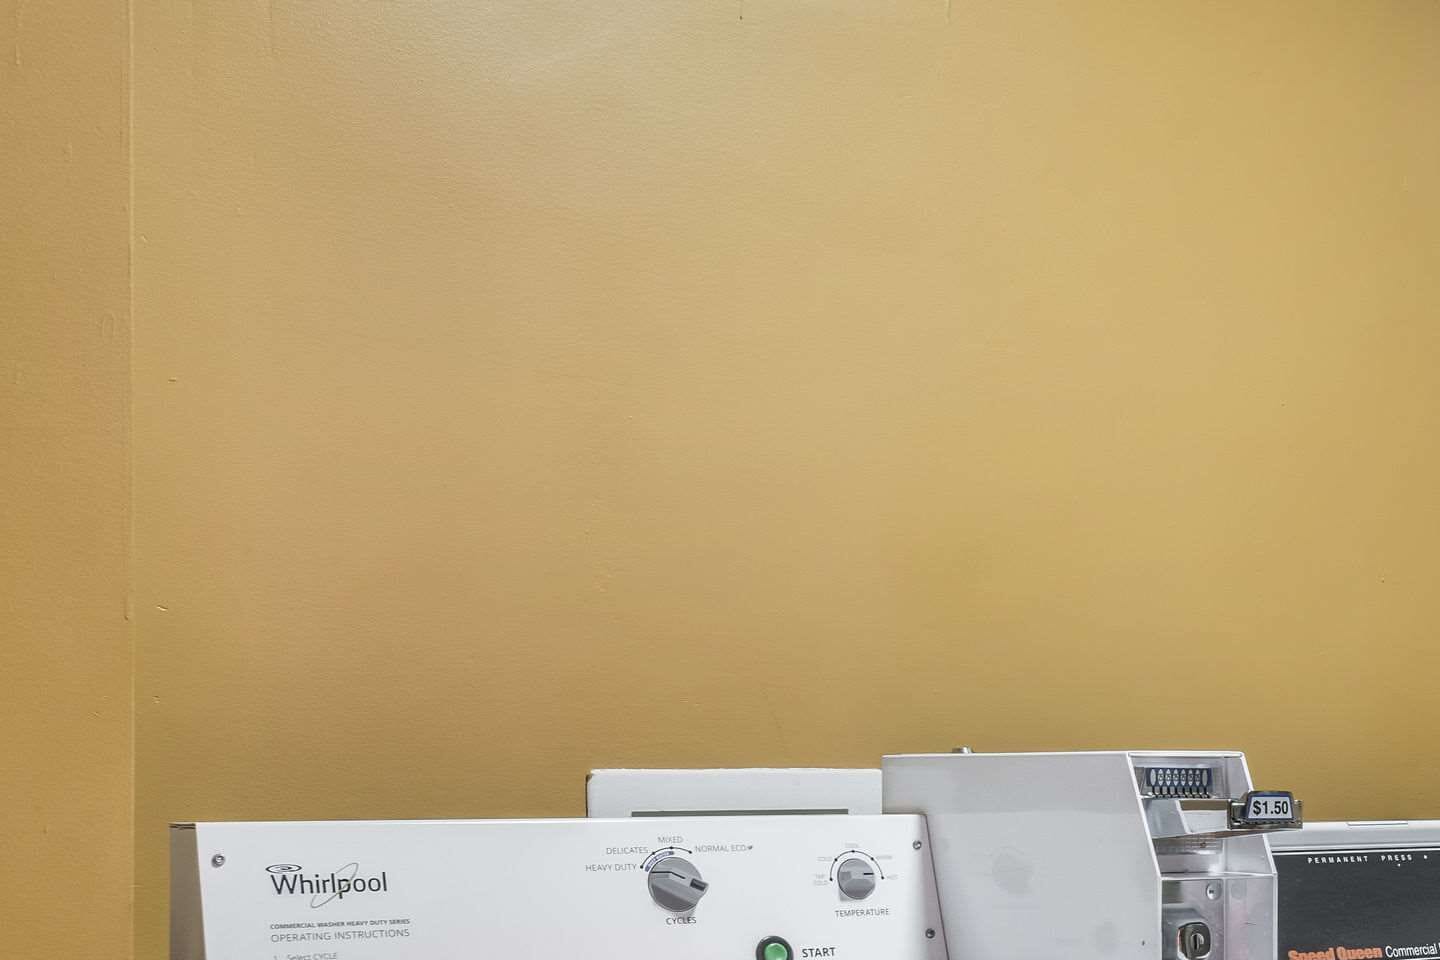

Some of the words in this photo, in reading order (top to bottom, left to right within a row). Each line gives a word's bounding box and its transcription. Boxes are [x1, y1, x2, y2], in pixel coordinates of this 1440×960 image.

[1252, 800, 1289, 815] $1.50
[657, 836, 683, 844] MIXED
[606, 846, 649, 855] DELICATES
[695, 845, 729, 853] NORMAL
[1307, 855, 1369, 864] PERMANENT
[1381, 854, 1413, 862] PRESS
[585, 864, 613, 872] HEAVY
[615, 863, 637, 872] DUTY
[270, 872, 387, 899] Whirlpool
[835, 908, 889, 917] TEMPERATURE
[270, 922, 315, 930] COMMERCIAL
[317, 920, 345, 928] WASHER
[346, 919, 368, 927] HEAVY
[665, 917, 697, 925] CYCLES
[270, 931, 332, 942] OPERATING
[334, 928, 410, 940] INSTRUCTIONS
[312, 952, 337, 960] CYCLE
[802, 946, 836, 959] START
[1336, 946, 1383, 960] Queen
[1385, 943, 1437, 958] Commercial
